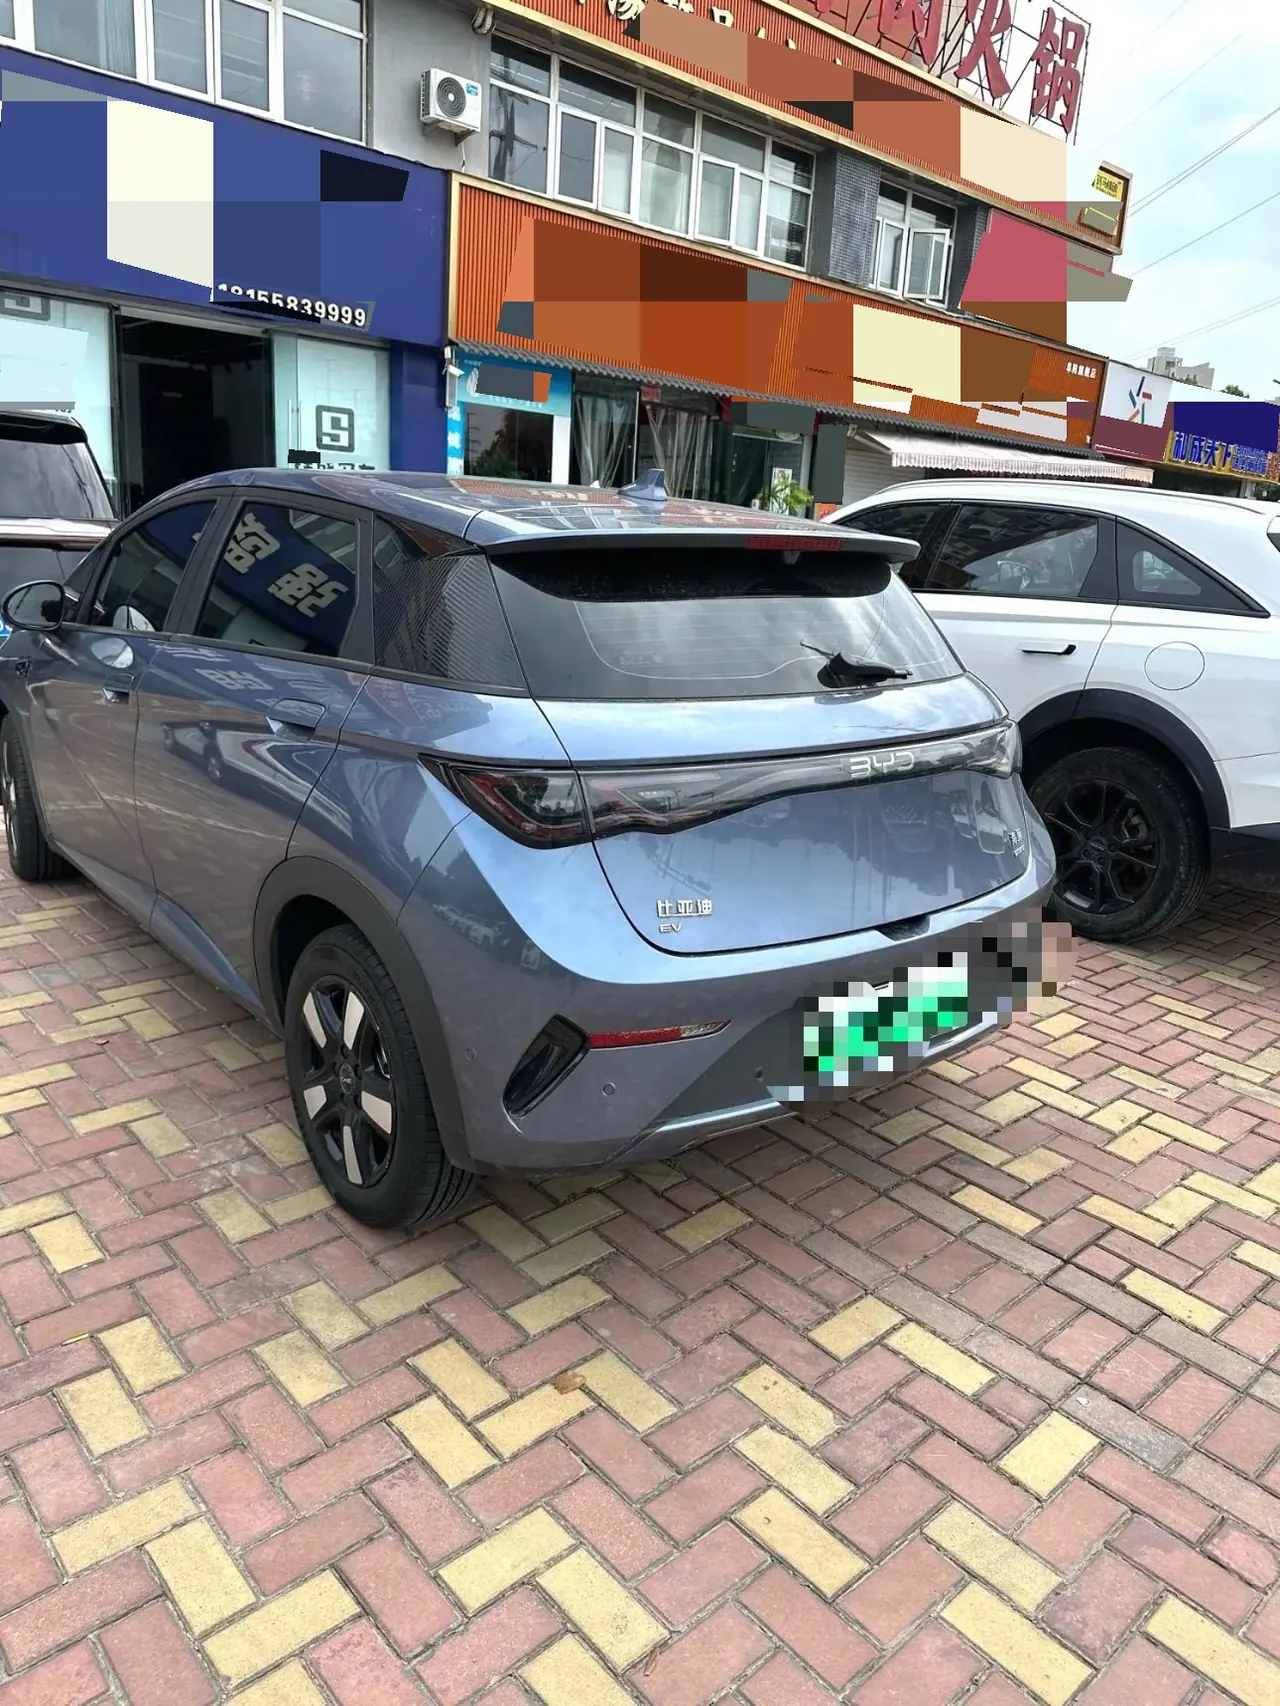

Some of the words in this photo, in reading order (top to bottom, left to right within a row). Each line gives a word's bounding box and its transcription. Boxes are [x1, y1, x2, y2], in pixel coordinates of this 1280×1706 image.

[849, 751, 915, 778] BYD
[656, 898, 713, 918] 比亚迪
[659, 923, 682, 933] EV
